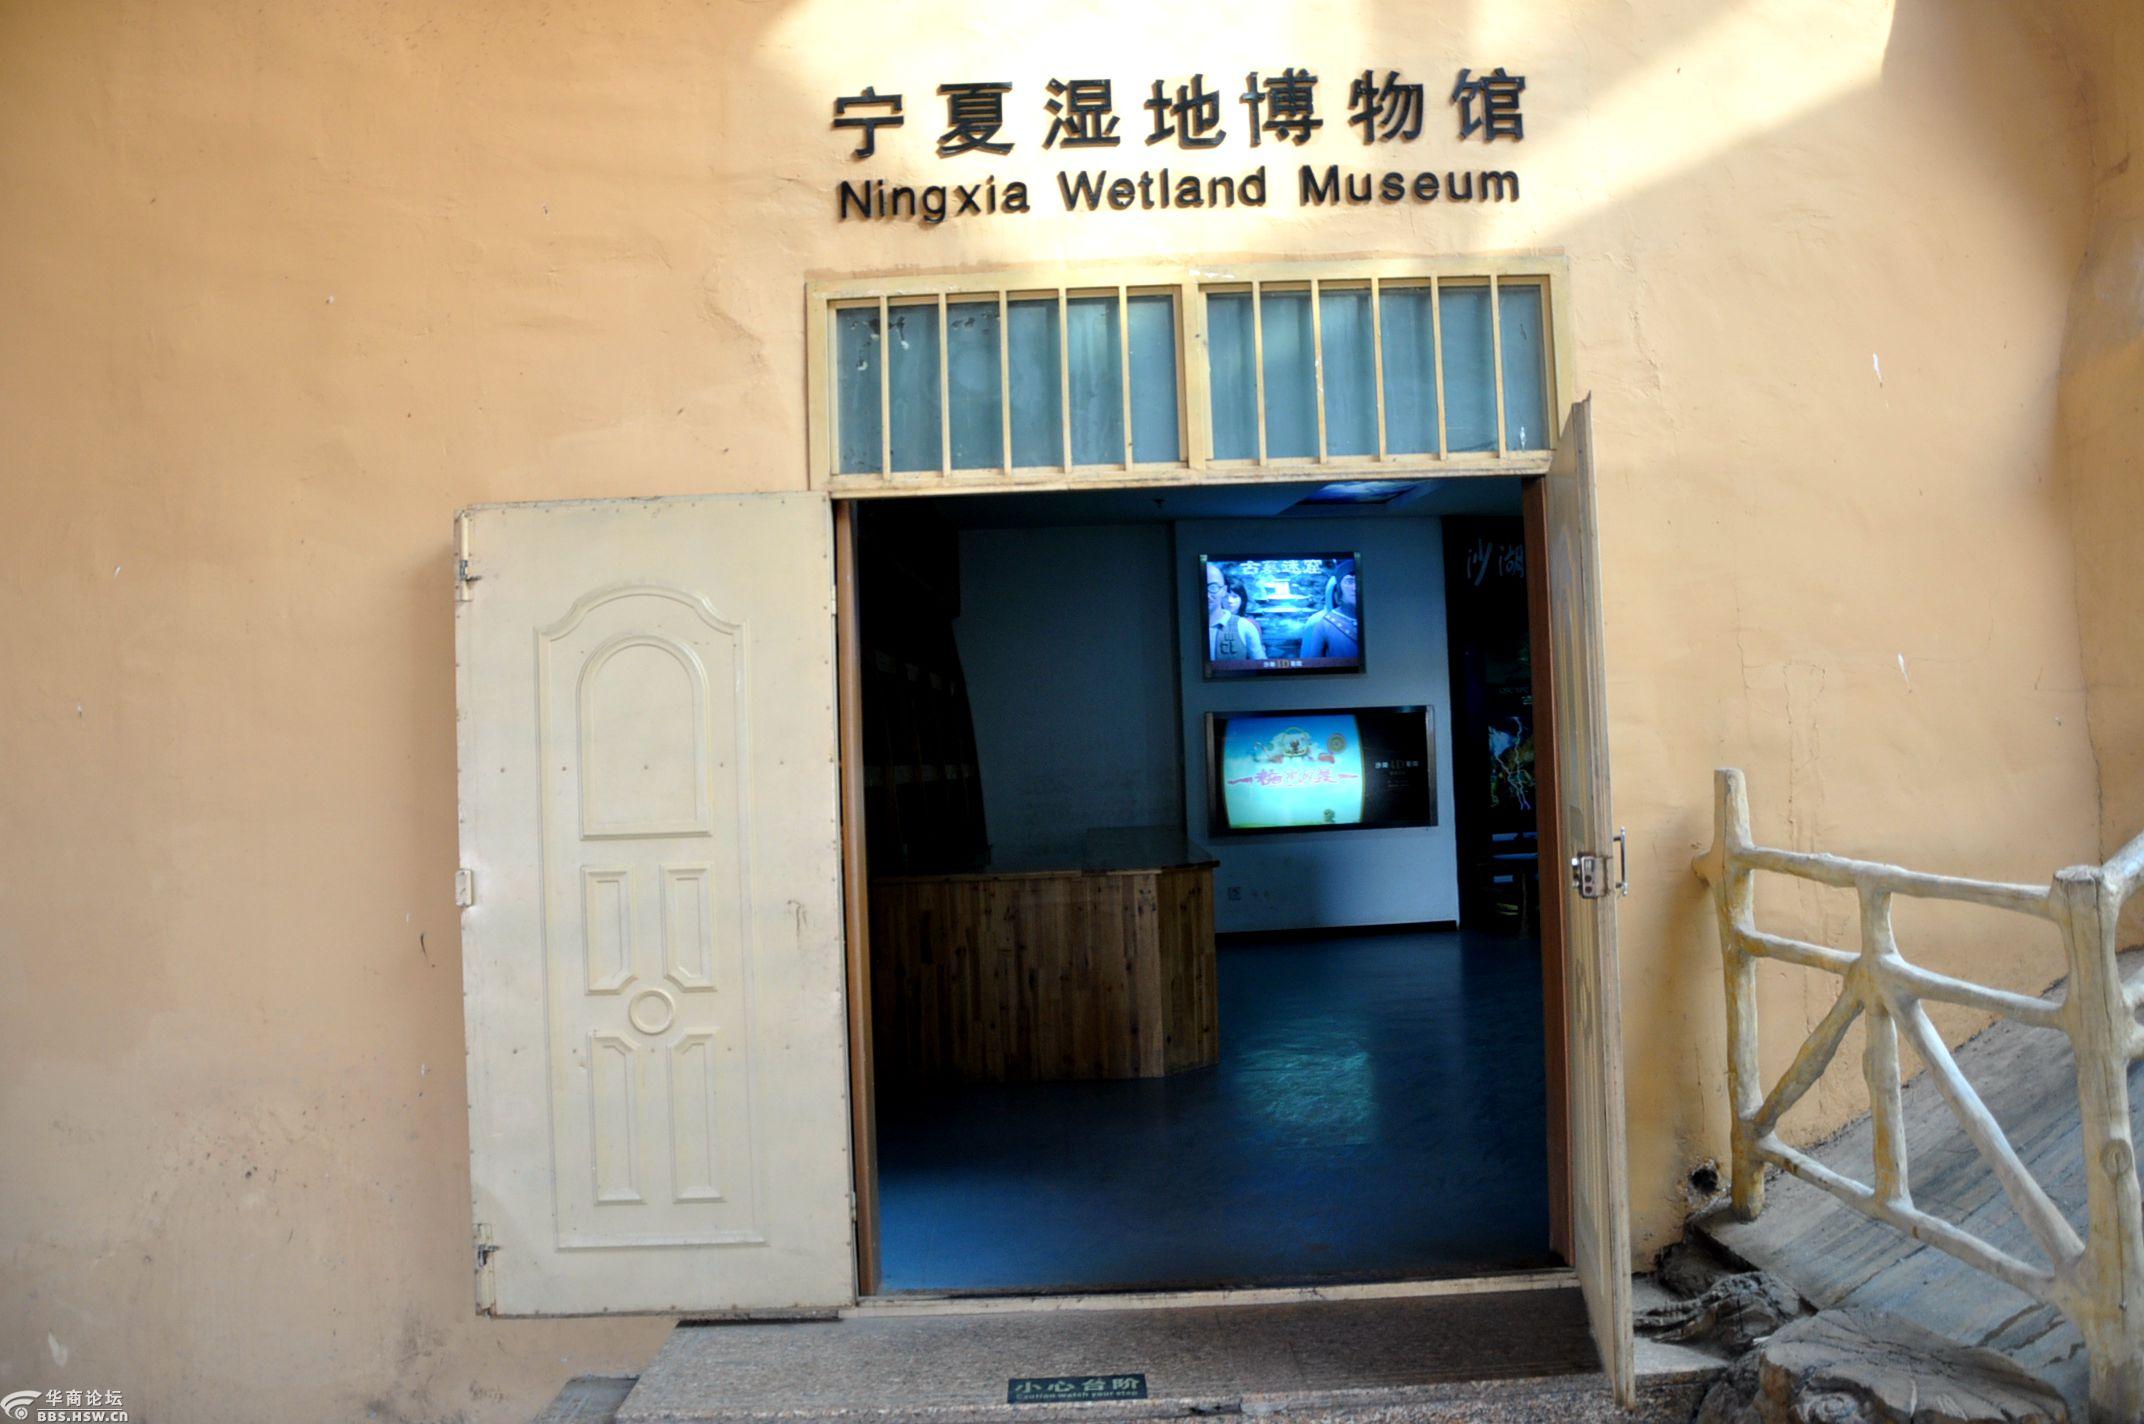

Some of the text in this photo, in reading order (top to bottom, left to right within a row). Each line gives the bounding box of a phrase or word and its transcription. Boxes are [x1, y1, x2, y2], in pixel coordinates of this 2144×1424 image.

[832, 66, 1526, 159] 宁夏湿地博物馆
[838, 164, 1520, 226] Ningxia Wetland Museum
[1015, 1377, 1140, 1393] 小心台阶
